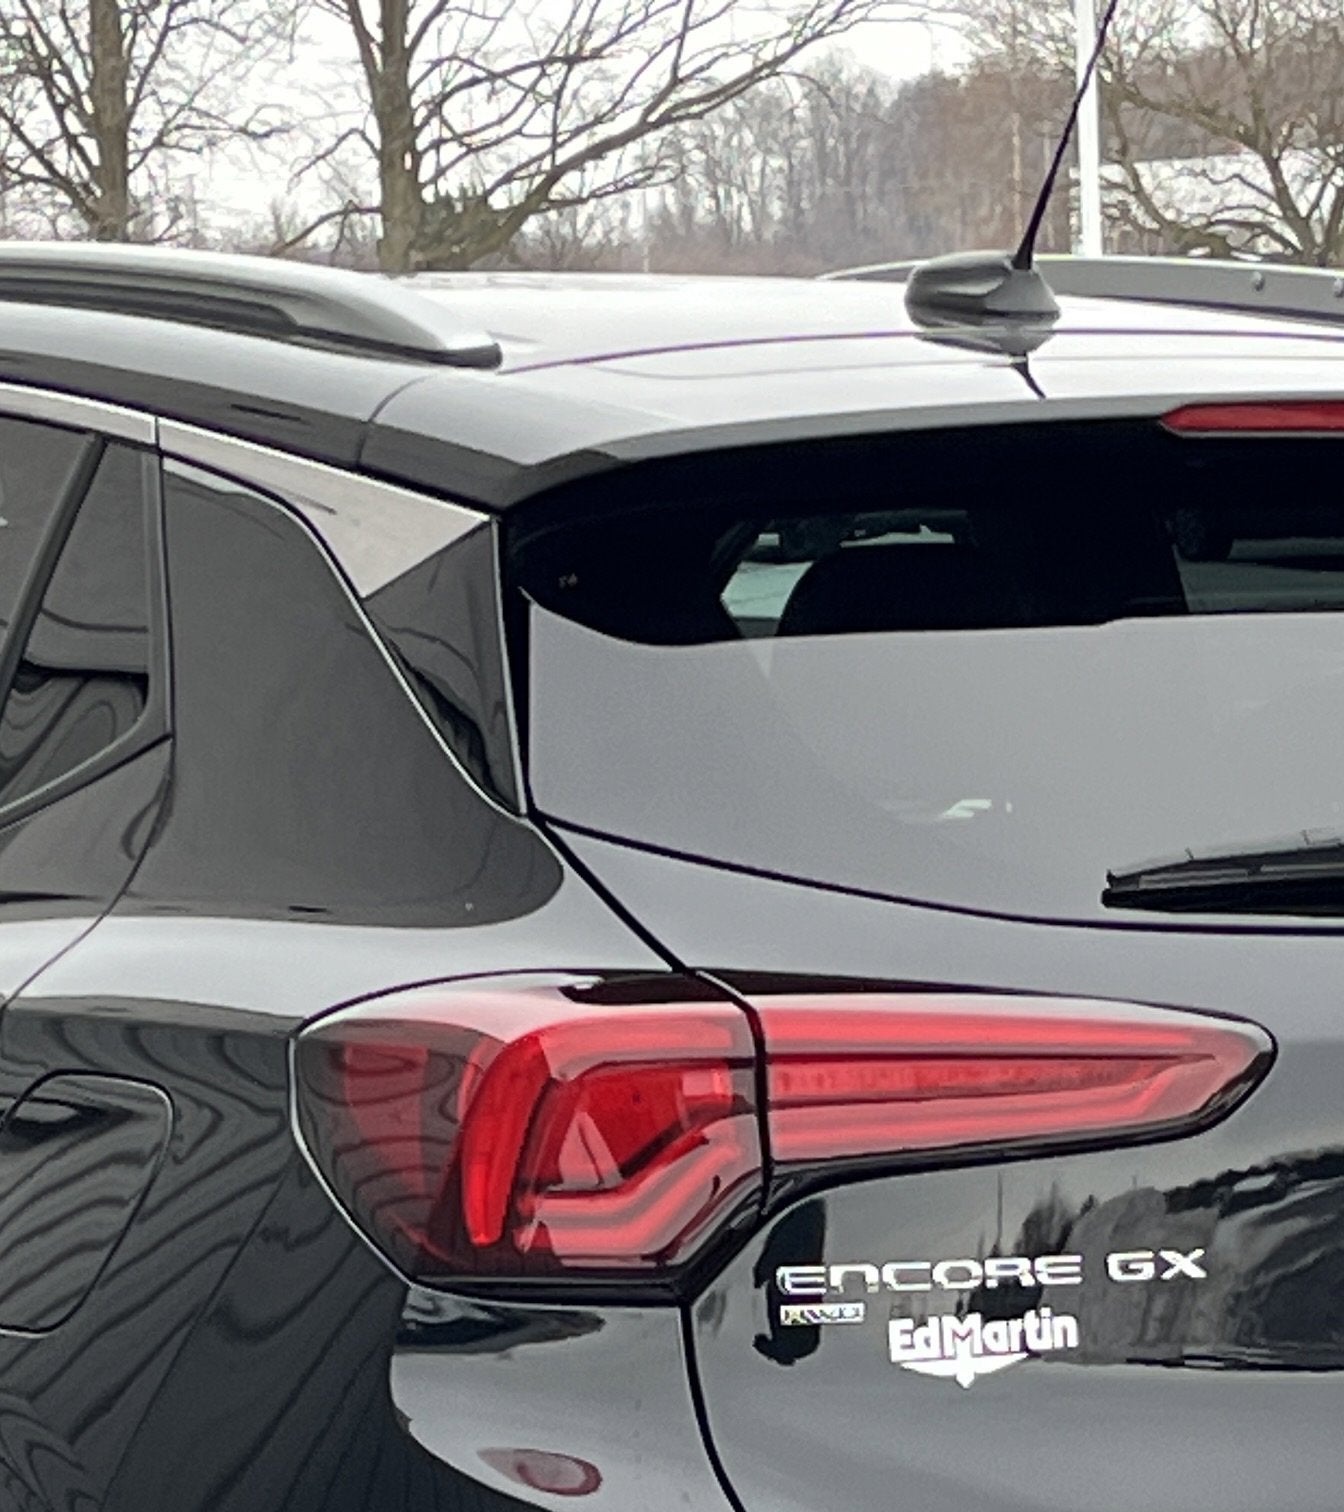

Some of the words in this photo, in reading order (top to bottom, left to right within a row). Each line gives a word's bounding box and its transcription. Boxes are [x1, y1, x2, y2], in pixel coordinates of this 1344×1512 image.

[776, 1254, 1083, 1296] ENCORE
[1106, 1247, 1208, 1283] GX
[887, 1306, 1080, 1365] EdMartin
